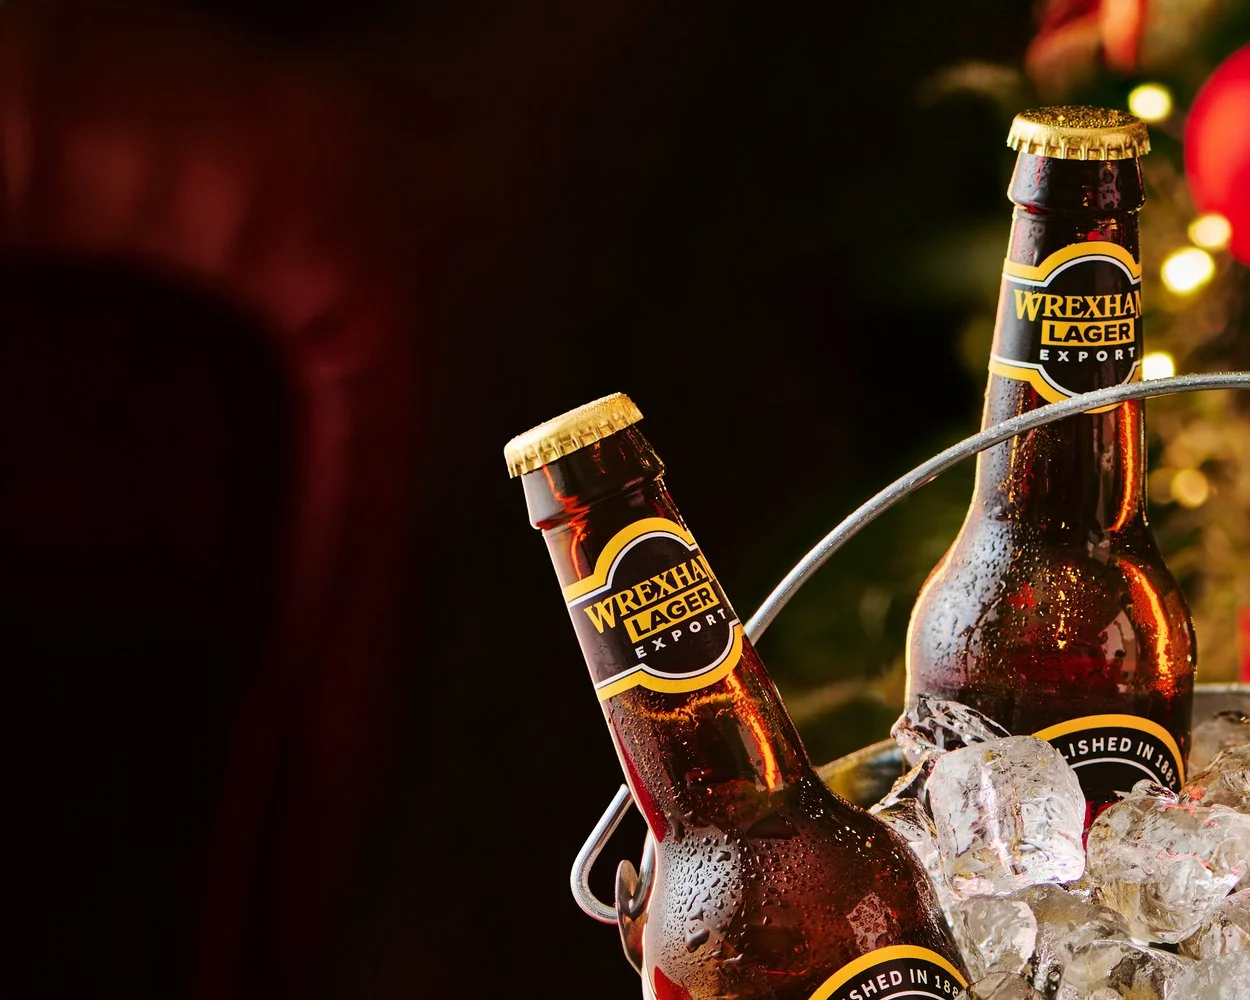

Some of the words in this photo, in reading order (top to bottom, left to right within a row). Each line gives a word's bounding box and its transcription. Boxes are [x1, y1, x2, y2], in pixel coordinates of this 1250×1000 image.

[1048, 322, 1131, 343] LAGER
[1039, 347, 1136, 362] EXPORT
[631, 587, 714, 638] LAGER
[635, 608, 727, 659] EXPORT
[1136, 741, 1154, 760] IN
[910, 968, 928, 985] IN
